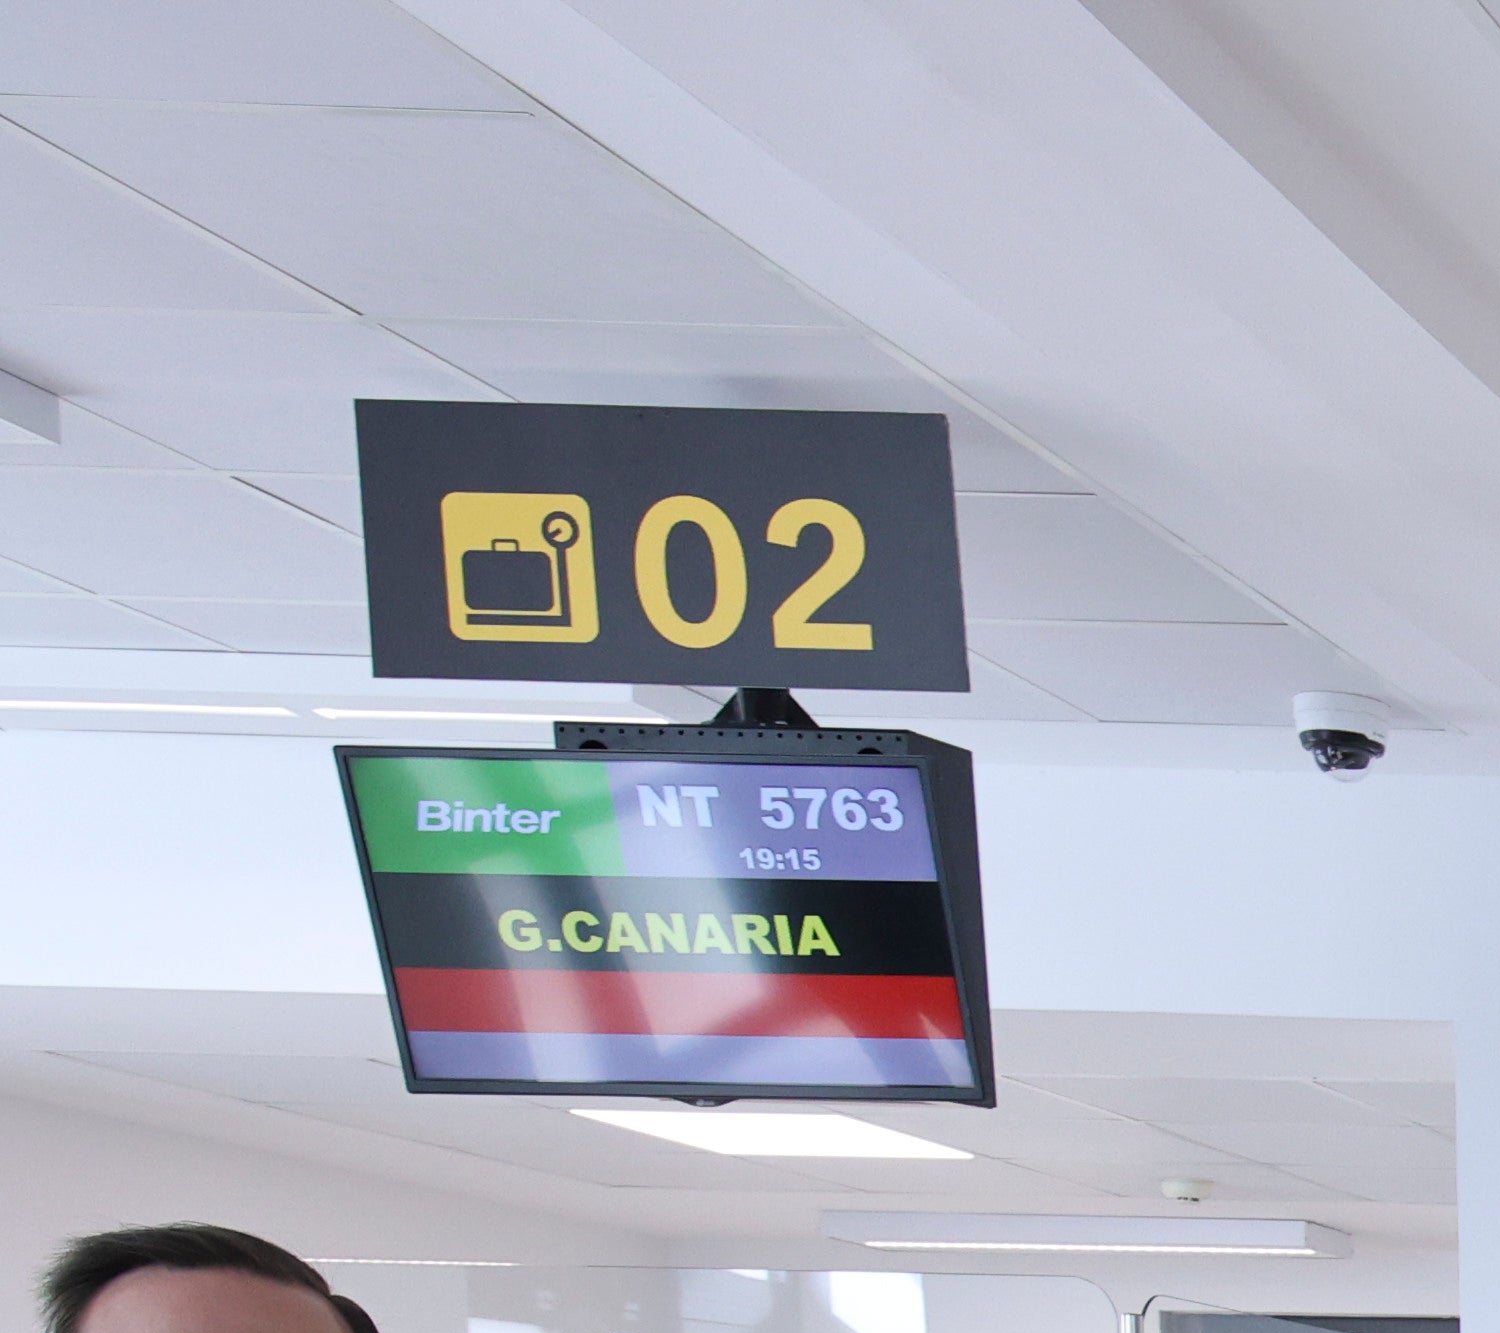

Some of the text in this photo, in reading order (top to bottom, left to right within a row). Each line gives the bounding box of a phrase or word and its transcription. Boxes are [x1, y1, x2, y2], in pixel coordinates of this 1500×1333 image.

[633, 494, 874, 651] 02
[416, 799, 561, 834] Binter
[636, 783, 904, 831] NT 5763
[739, 847, 822, 871] 19:15
[498, 909, 841, 957] G.CANARIA
